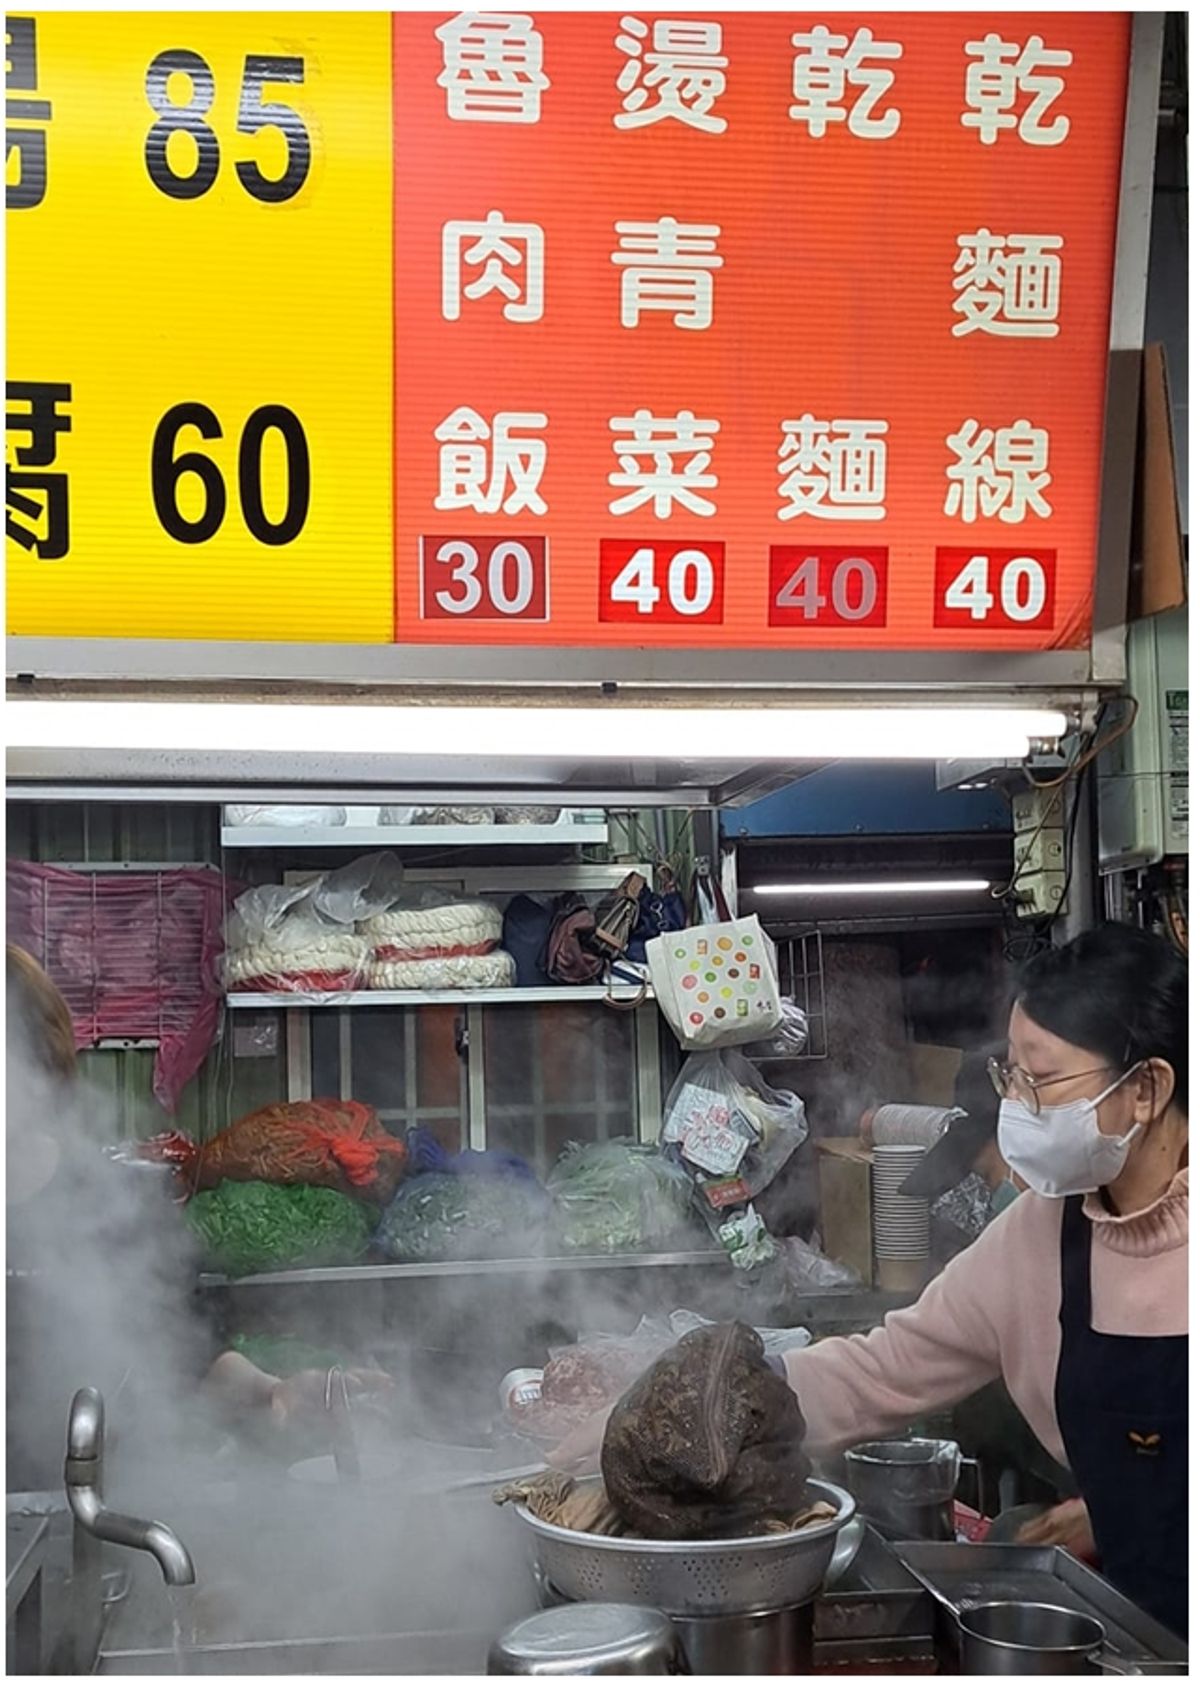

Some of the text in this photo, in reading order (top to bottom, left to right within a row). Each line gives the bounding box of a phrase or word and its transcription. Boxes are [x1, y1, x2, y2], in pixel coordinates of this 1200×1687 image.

[144, 48, 312, 204] 85
[434, 12, 550, 516] 魯肉飯
[609, 16, 728, 520] 燙青菜
[944, 33, 1073, 524] 乾麵線
[151, 401, 311, 546] 60
[435, 540, 534, 614] 30
[610, 548, 714, 615] 40
[776, 556, 878, 620] 40
[945, 556, 1046, 621] 40
